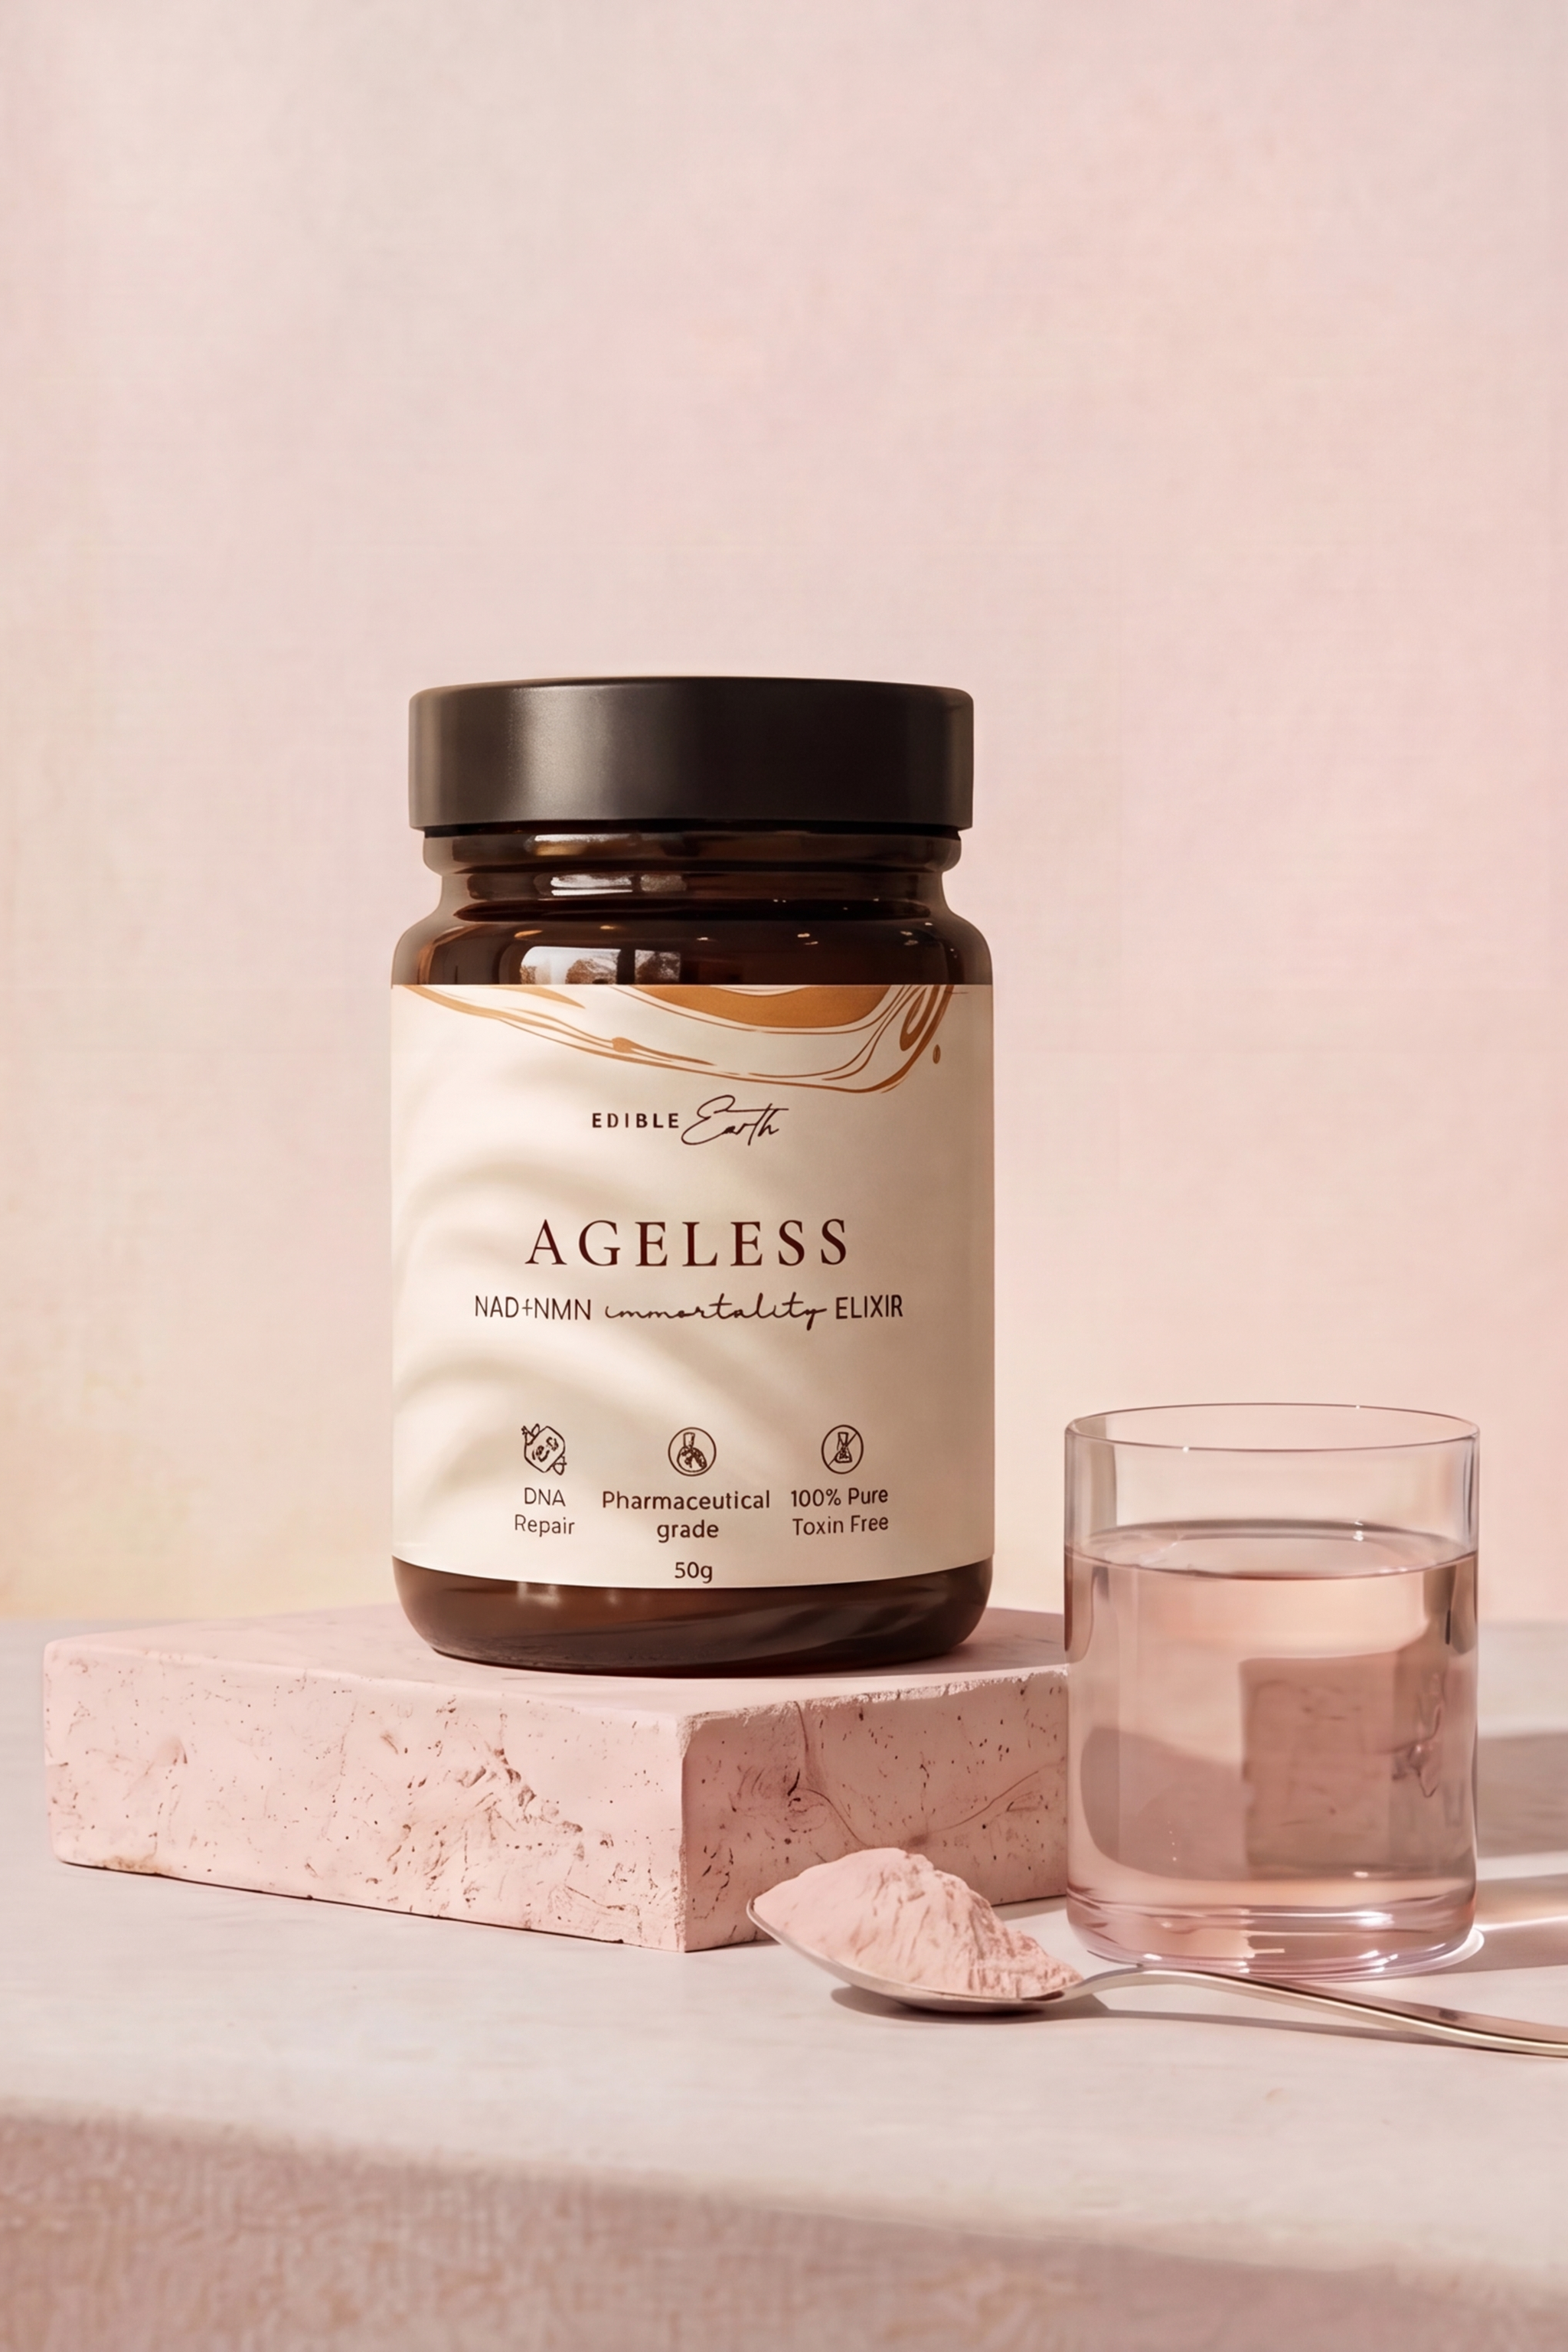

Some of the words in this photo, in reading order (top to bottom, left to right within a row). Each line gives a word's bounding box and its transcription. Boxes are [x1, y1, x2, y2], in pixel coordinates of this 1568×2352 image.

[592, 1112, 679, 1129] EDIBLE
[680, 1094, 789, 1147] Earth
[524, 1218, 847, 1267] AGELESS
[475, 1295, 592, 1321] NAD+NMN
[604, 1291, 828, 1331] immortality
[835, 1294, 903, 1320] ELIXIR
[524, 1487, 567, 1508] DNA
[602, 1489, 770, 1511] Pharmaceutical
[790, 1488, 841, 1508] 100%
[848, 1487, 889, 1505] Pure
[514, 1514, 576, 1538] Repair
[656, 1519, 720, 1544] grade
[792, 1515, 844, 1536] Toxin
[851, 1514, 889, 1533] Free
[675, 1561, 713, 1584] 50g
